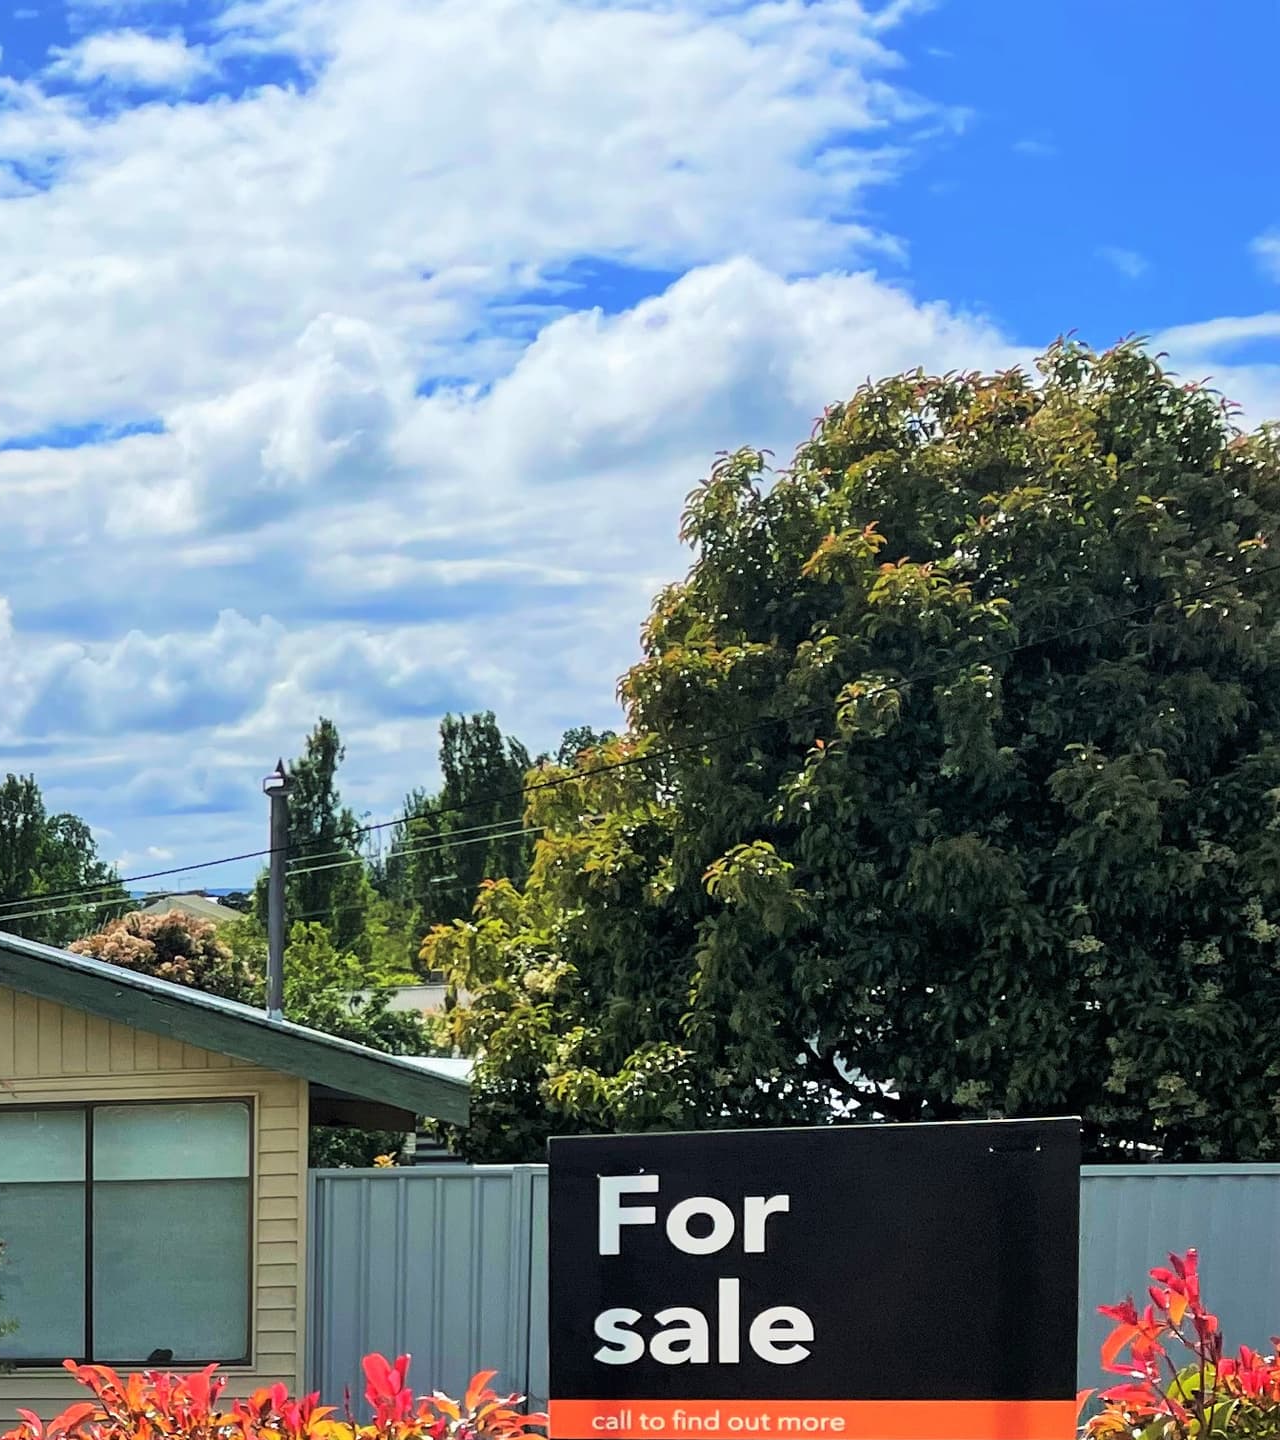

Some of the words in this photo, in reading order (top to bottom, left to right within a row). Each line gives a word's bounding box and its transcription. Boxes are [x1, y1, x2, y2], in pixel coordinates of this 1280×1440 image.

[596, 1173, 790, 1256] For
[593, 1277, 815, 1365] sale
[591, 1409, 632, 1431] call
[639, 1413, 667, 1431] to
[671, 1409, 720, 1431] find
[727, 1413, 772, 1431] out
[777, 1416, 846, 1432] more
